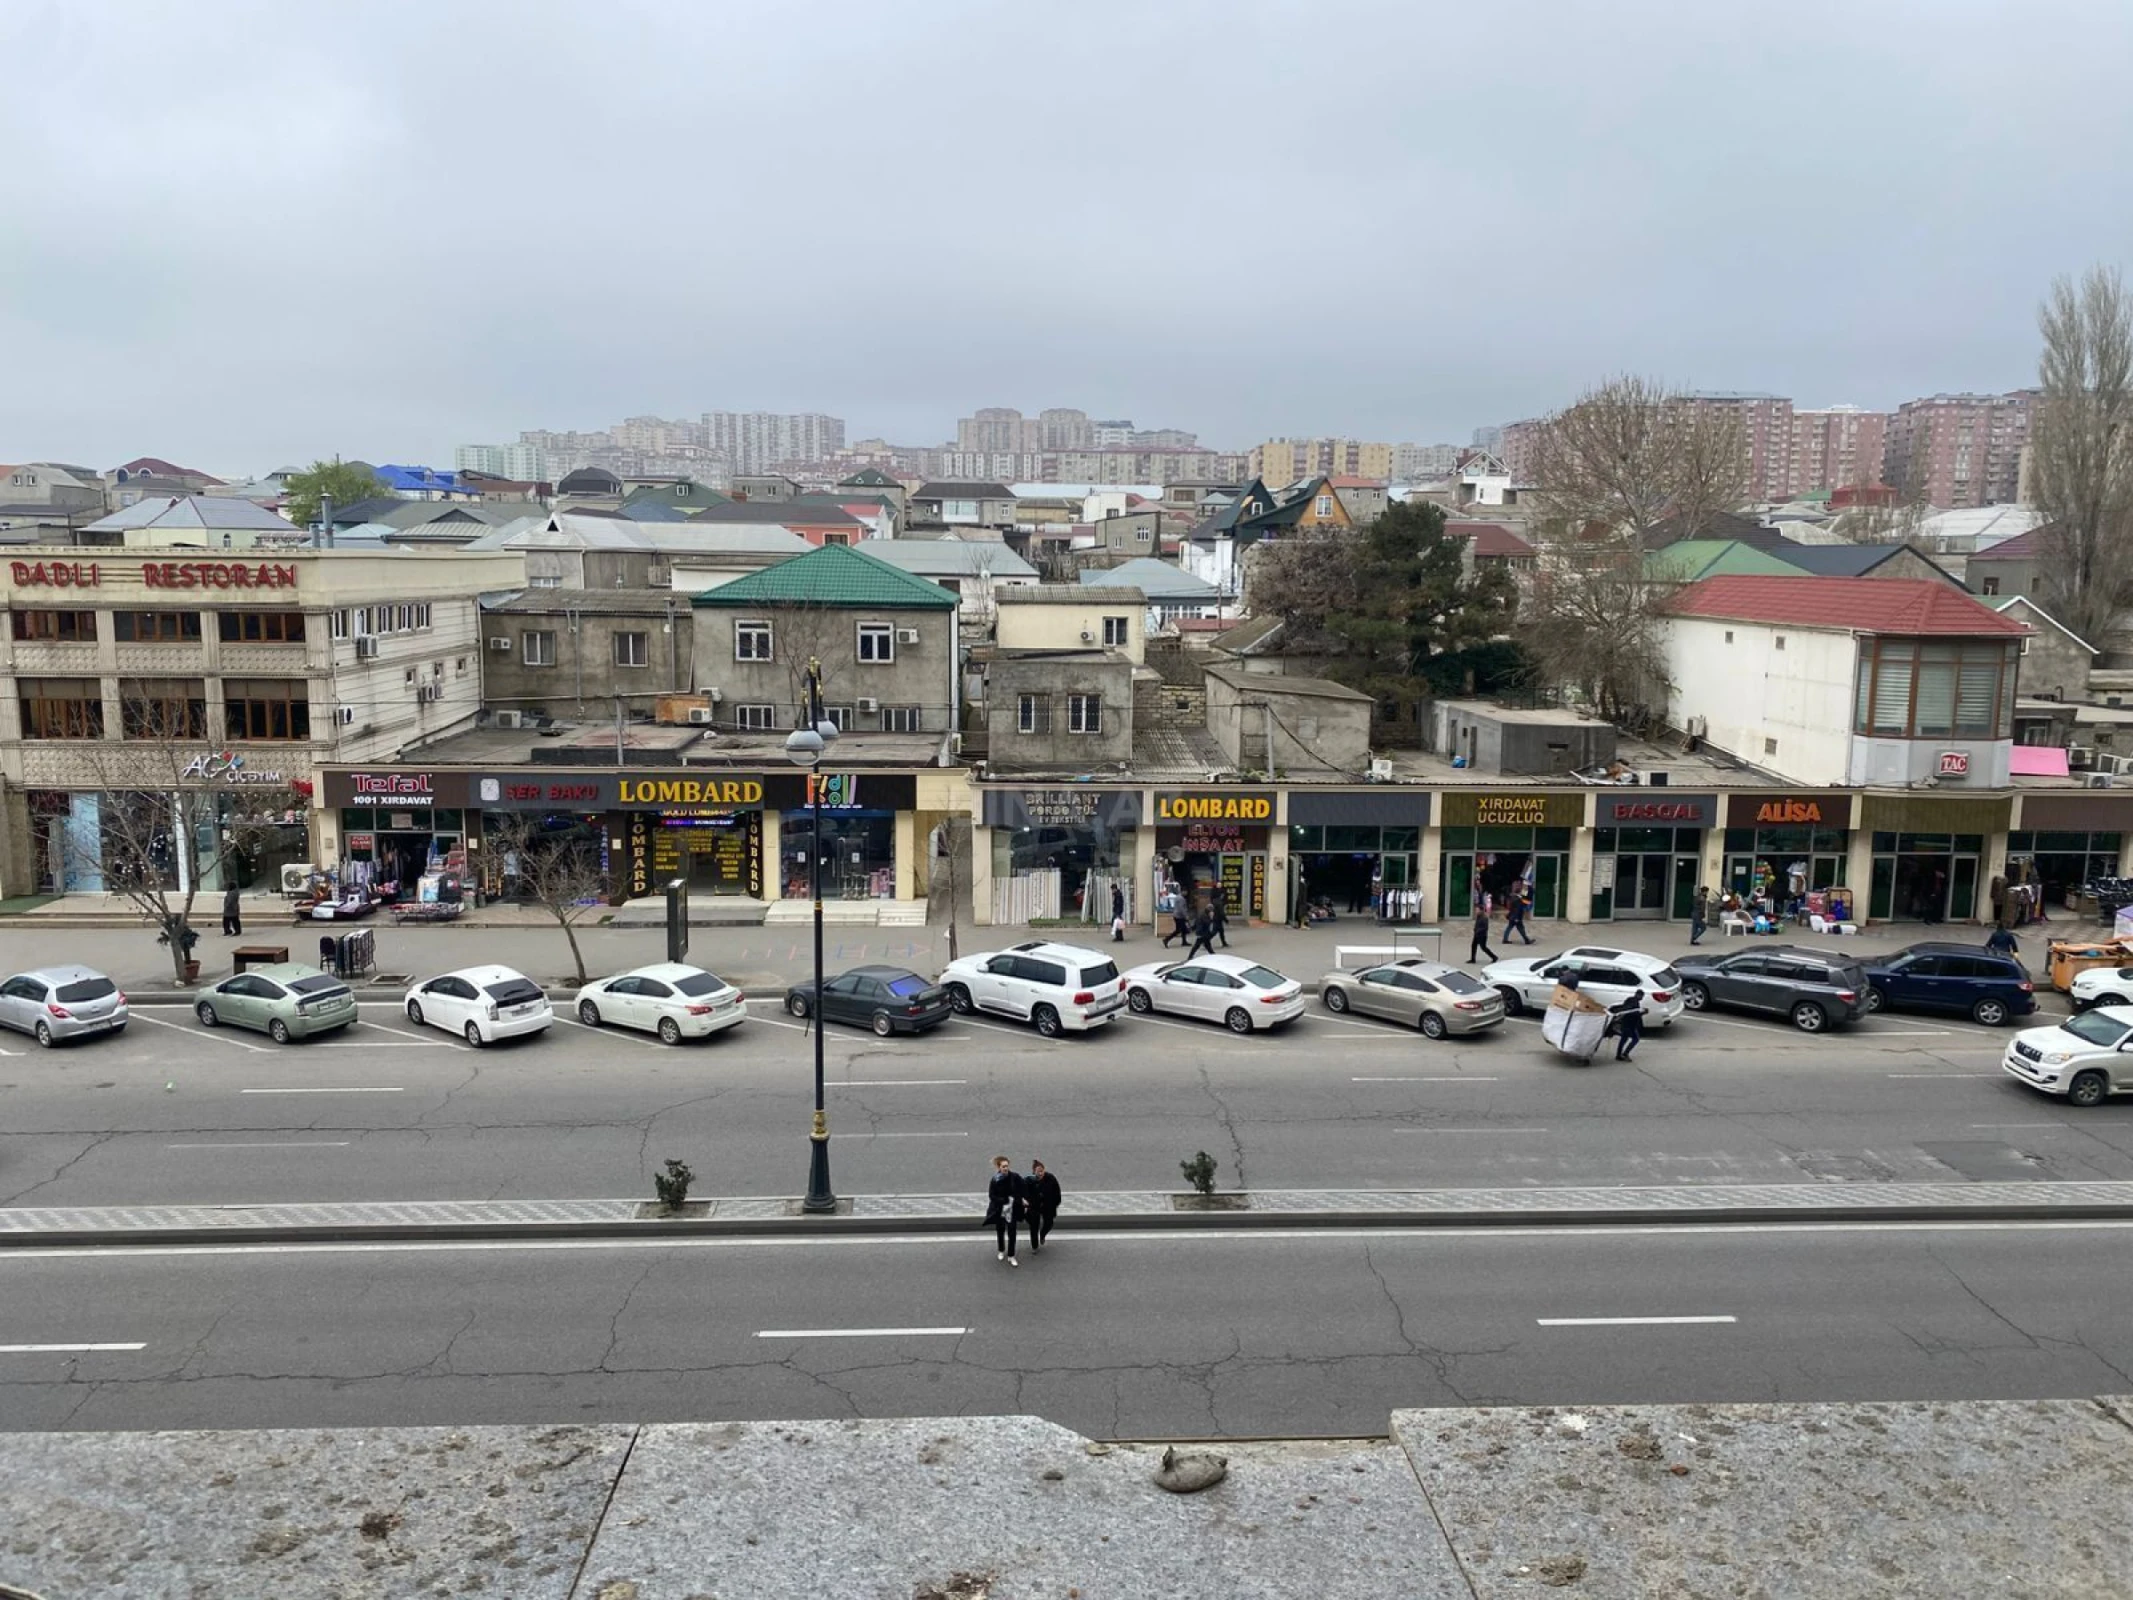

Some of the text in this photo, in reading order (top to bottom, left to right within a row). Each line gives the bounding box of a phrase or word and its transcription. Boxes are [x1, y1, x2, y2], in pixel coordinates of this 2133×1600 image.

[142, 562, 297, 588] RESTORAN
[351, 774, 433, 792] Tefal
[619, 781, 763, 802] LOMBARD
[353, 796, 434, 805] 1001 XIRDAVAT
[1160, 798, 1271, 818] LOMBARD
[1478, 798, 1546, 810] XIRDAVAT
[1757, 799, 1821, 821] ALİSA
[1478, 812, 1545, 824] UCUZLUQ
[632, 812, 646, 892] LOMBARD
[749, 812, 759, 892] LOMBARD
